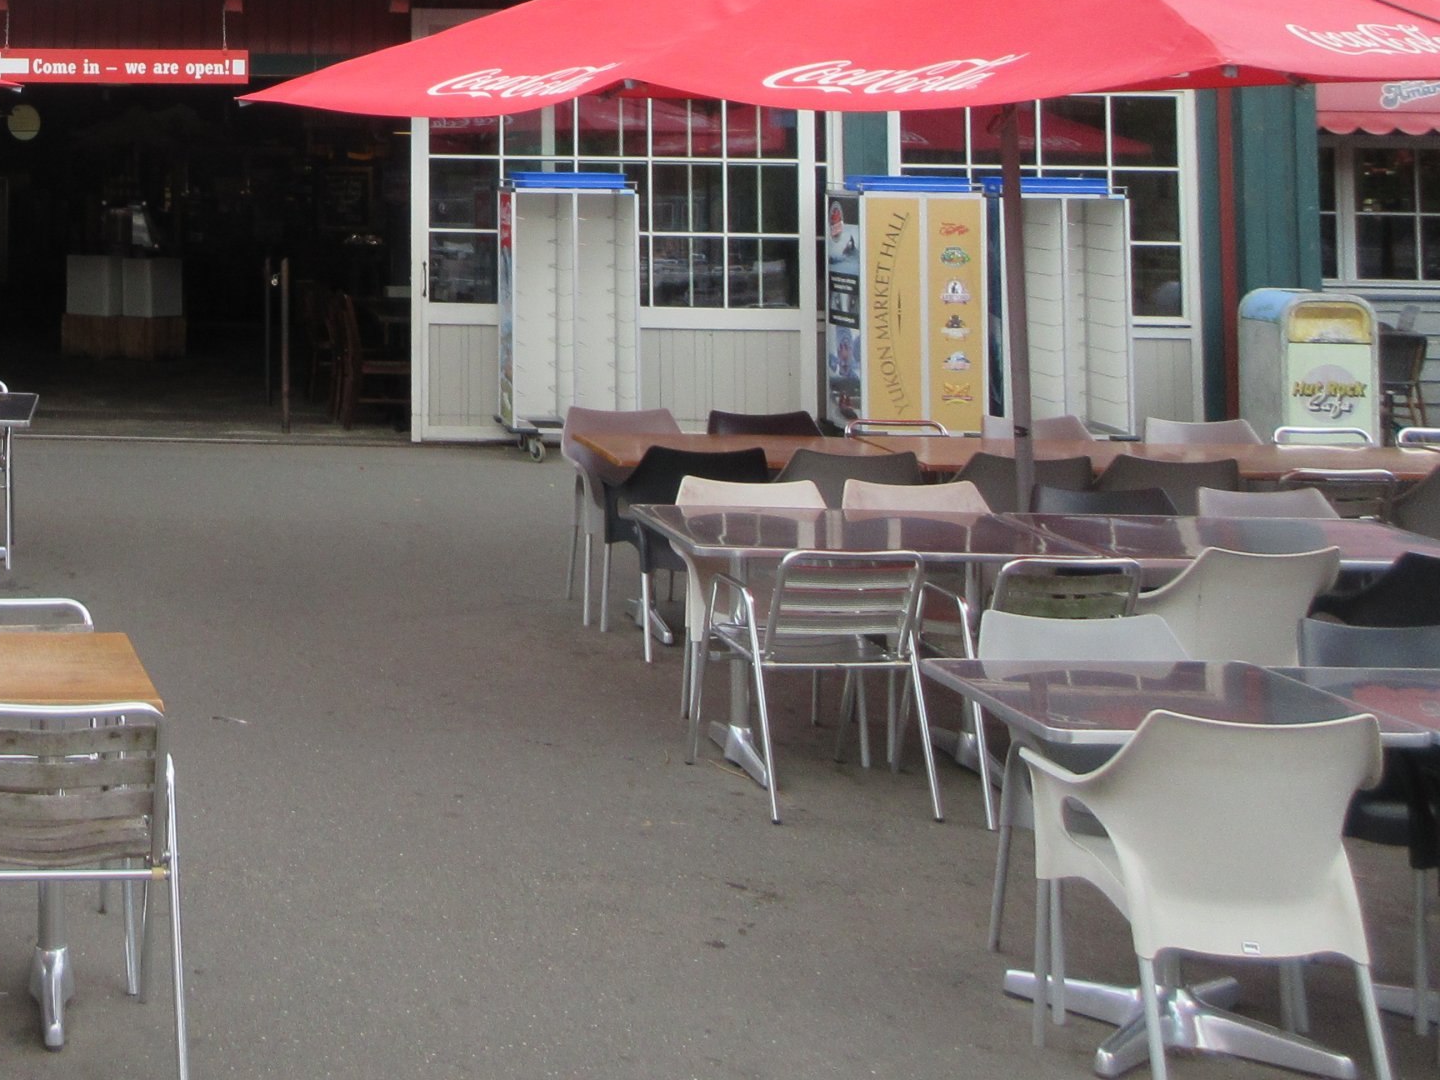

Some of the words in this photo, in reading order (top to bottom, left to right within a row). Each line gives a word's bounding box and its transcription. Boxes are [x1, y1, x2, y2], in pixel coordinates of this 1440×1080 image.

[32, 58, 77, 75] Come
[83, 58, 100, 75] in
[125, 62, 147, 75] we
[153, 62, 179, 75] are
[185, 58, 230, 80] open!
[426, 61, 624, 98] Coca-Cola
[762, 51, 1031, 94] Coca-Cola
[881, 211, 911, 259] HALL
[872, 264, 893, 341] MARKET
[880, 347, 910, 416] YUKON
